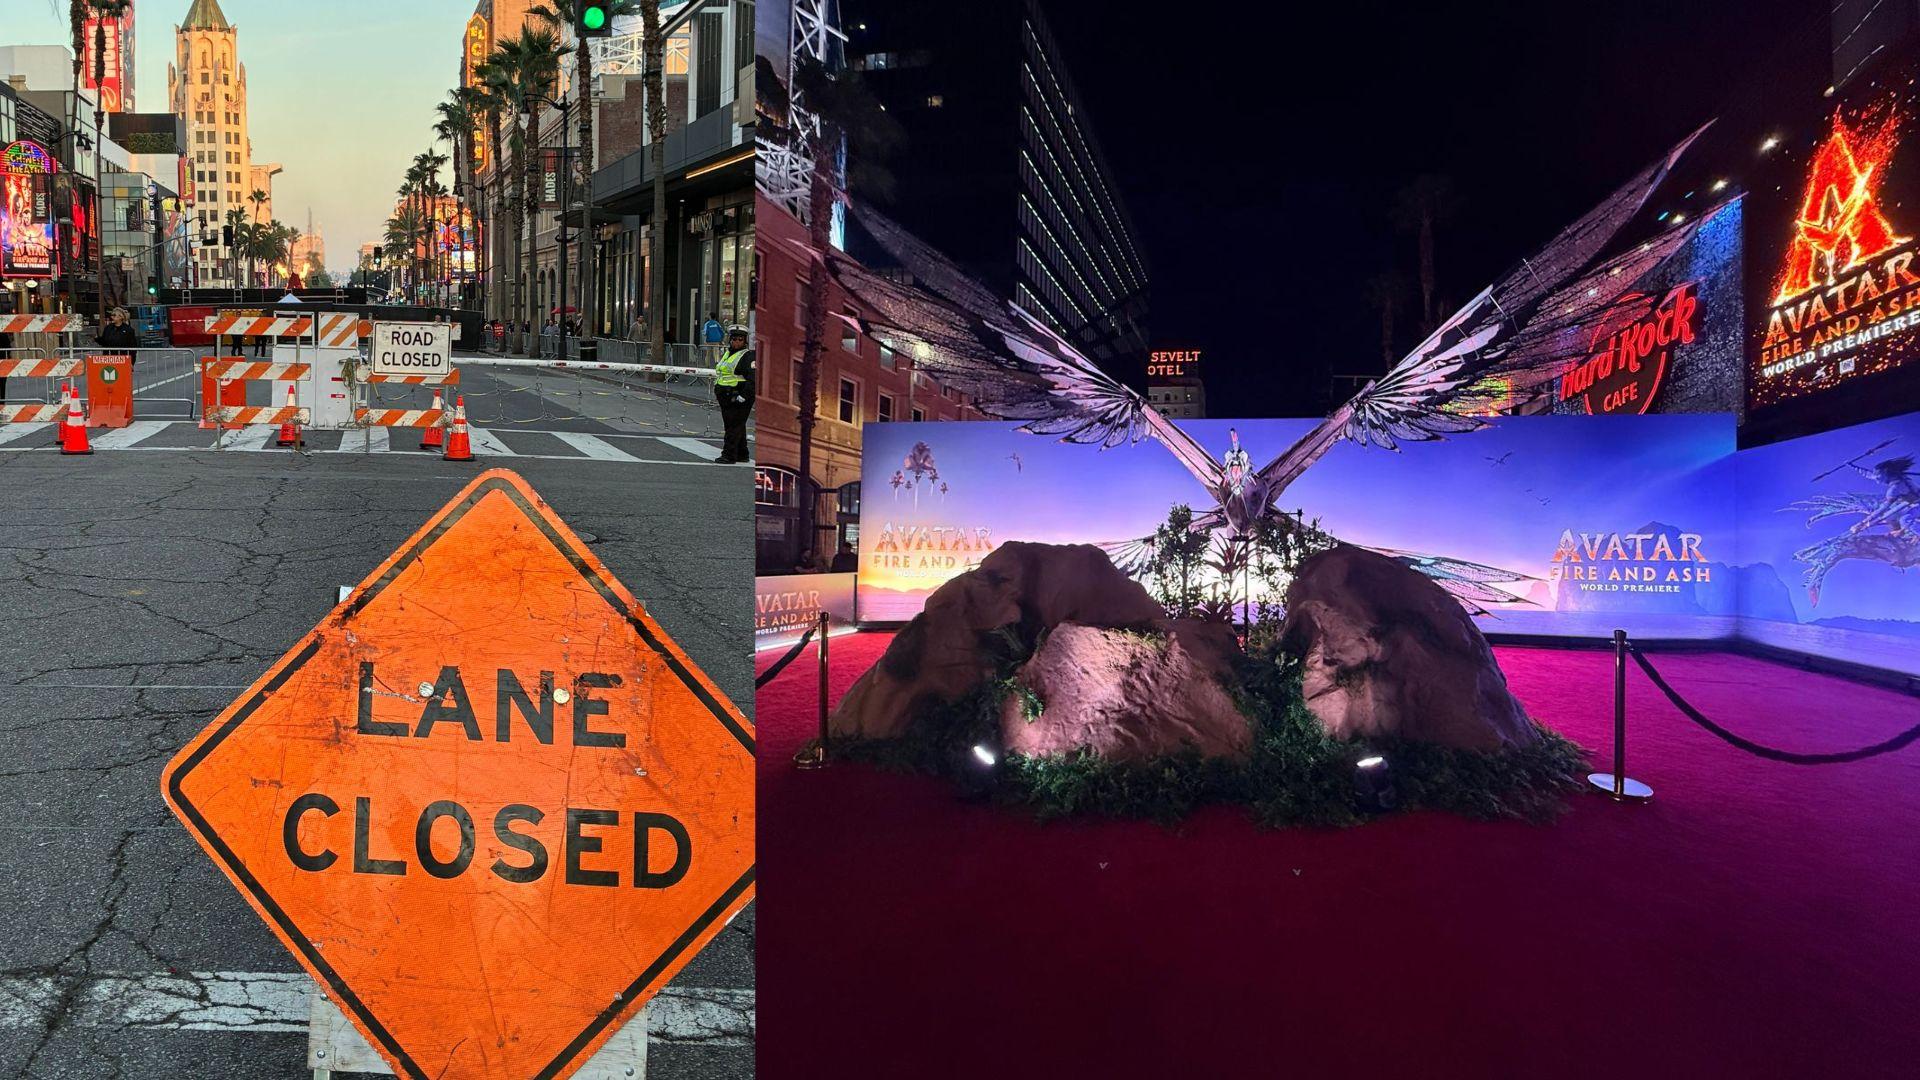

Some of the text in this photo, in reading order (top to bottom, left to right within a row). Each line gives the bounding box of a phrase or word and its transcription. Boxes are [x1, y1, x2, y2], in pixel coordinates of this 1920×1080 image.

[10, 153, 45, 166] CHINESE
[1761, 251, 1920, 349] AVATAR
[1618, 287, 1696, 373] Rock
[1761, 287, 1920, 366] FIRE AND ASH
[391, 331, 433, 346] ROAD
[1762, 310, 1920, 378] WORLD PREMIERE
[382, 352, 442, 367] CLOSED
[1150, 351, 1201, 362] SEVELT
[1147, 365, 1184, 376] OTEL
[1603, 382, 1638, 412] CAFE
[874, 522, 993, 552] AVATAR
[1551, 528, 1710, 563] AVATAR
[873, 555, 910, 568] FIRE
[919, 556, 955, 569] AND
[1550, 565, 1711, 582] FIRE AND ASH
[1580, 583, 1680, 593] WORLD PREMIERE
[756, 590, 822, 614] VATAR
[756, 623, 809, 636] WORLD PREMIERE
[771, 613, 797, 626] AND
[357, 661, 627, 748] LANE
[283, 793, 692, 889] CLOSED
